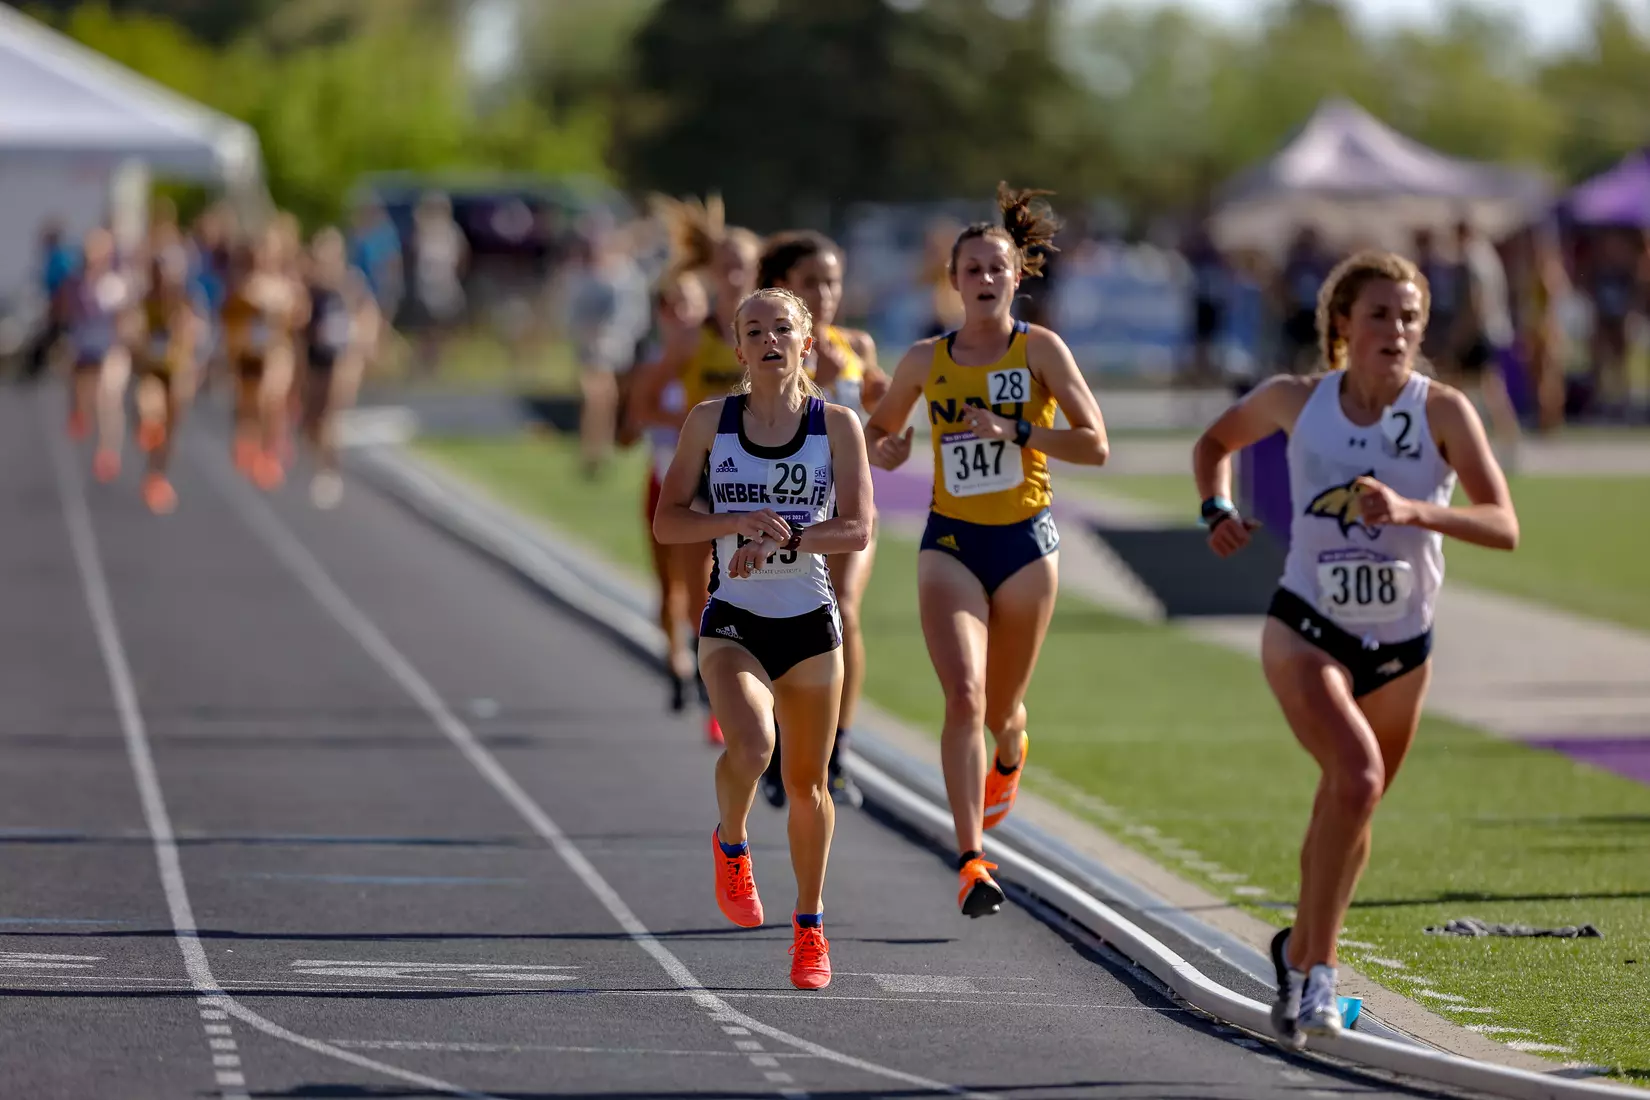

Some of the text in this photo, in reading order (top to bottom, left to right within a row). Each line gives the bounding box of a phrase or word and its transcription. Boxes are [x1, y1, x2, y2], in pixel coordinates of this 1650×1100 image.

[995, 371, 1024, 401] 28
[1392, 411, 1411, 450] 2
[716, 465, 738, 473] adidas
[953, 440, 1005, 480] 347
[713, 483, 771, 503] WEBER
[773, 463, 806, 496] 29
[1333, 564, 1396, 605] 308
